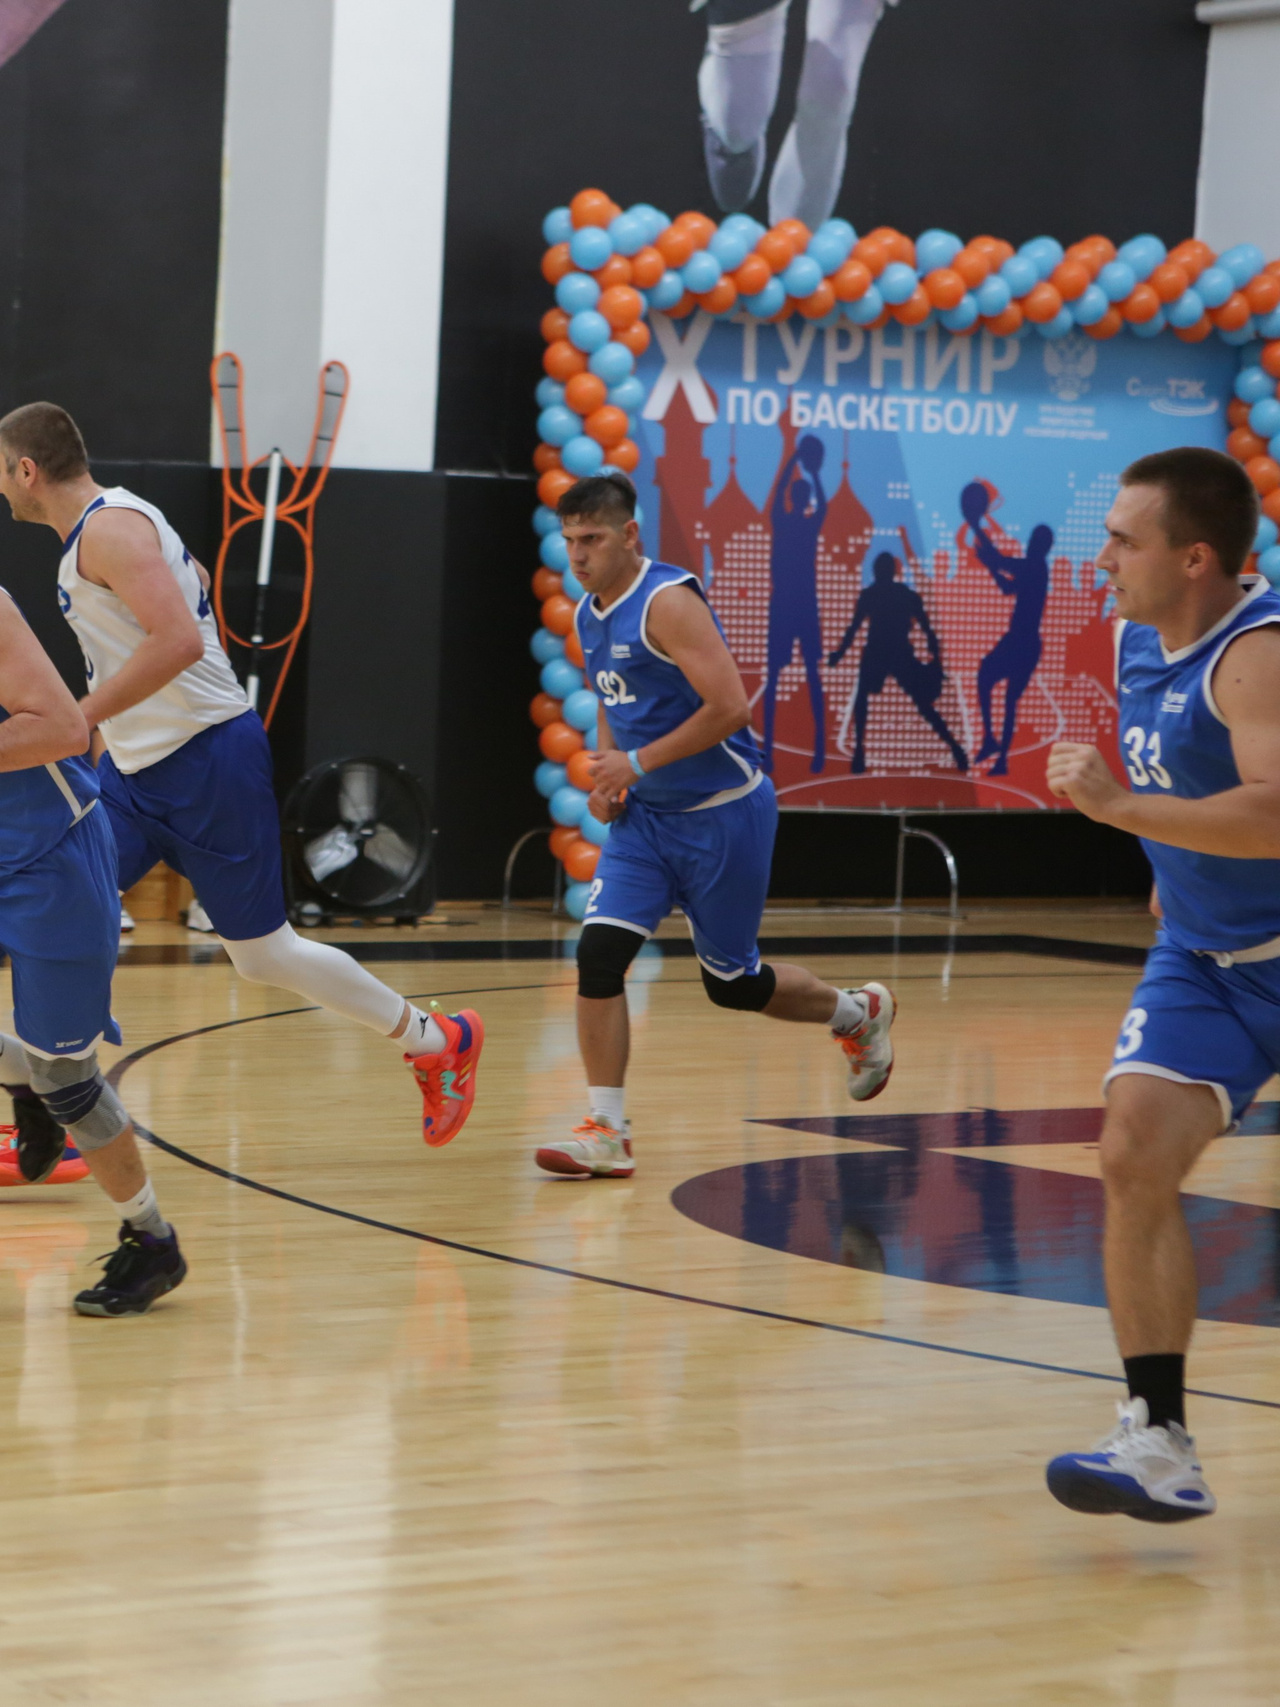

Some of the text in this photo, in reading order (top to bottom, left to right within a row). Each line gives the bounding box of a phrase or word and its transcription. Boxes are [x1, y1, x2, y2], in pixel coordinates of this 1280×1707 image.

[730, 313, 1020, 394] ТУРНИР
[726, 388, 1019, 437] ПО БАСКЕТБОЛУ
[596, 670, 637, 707] 92
[1123, 725, 1173, 789] 33
[1114, 1007, 1148, 1060] 3
